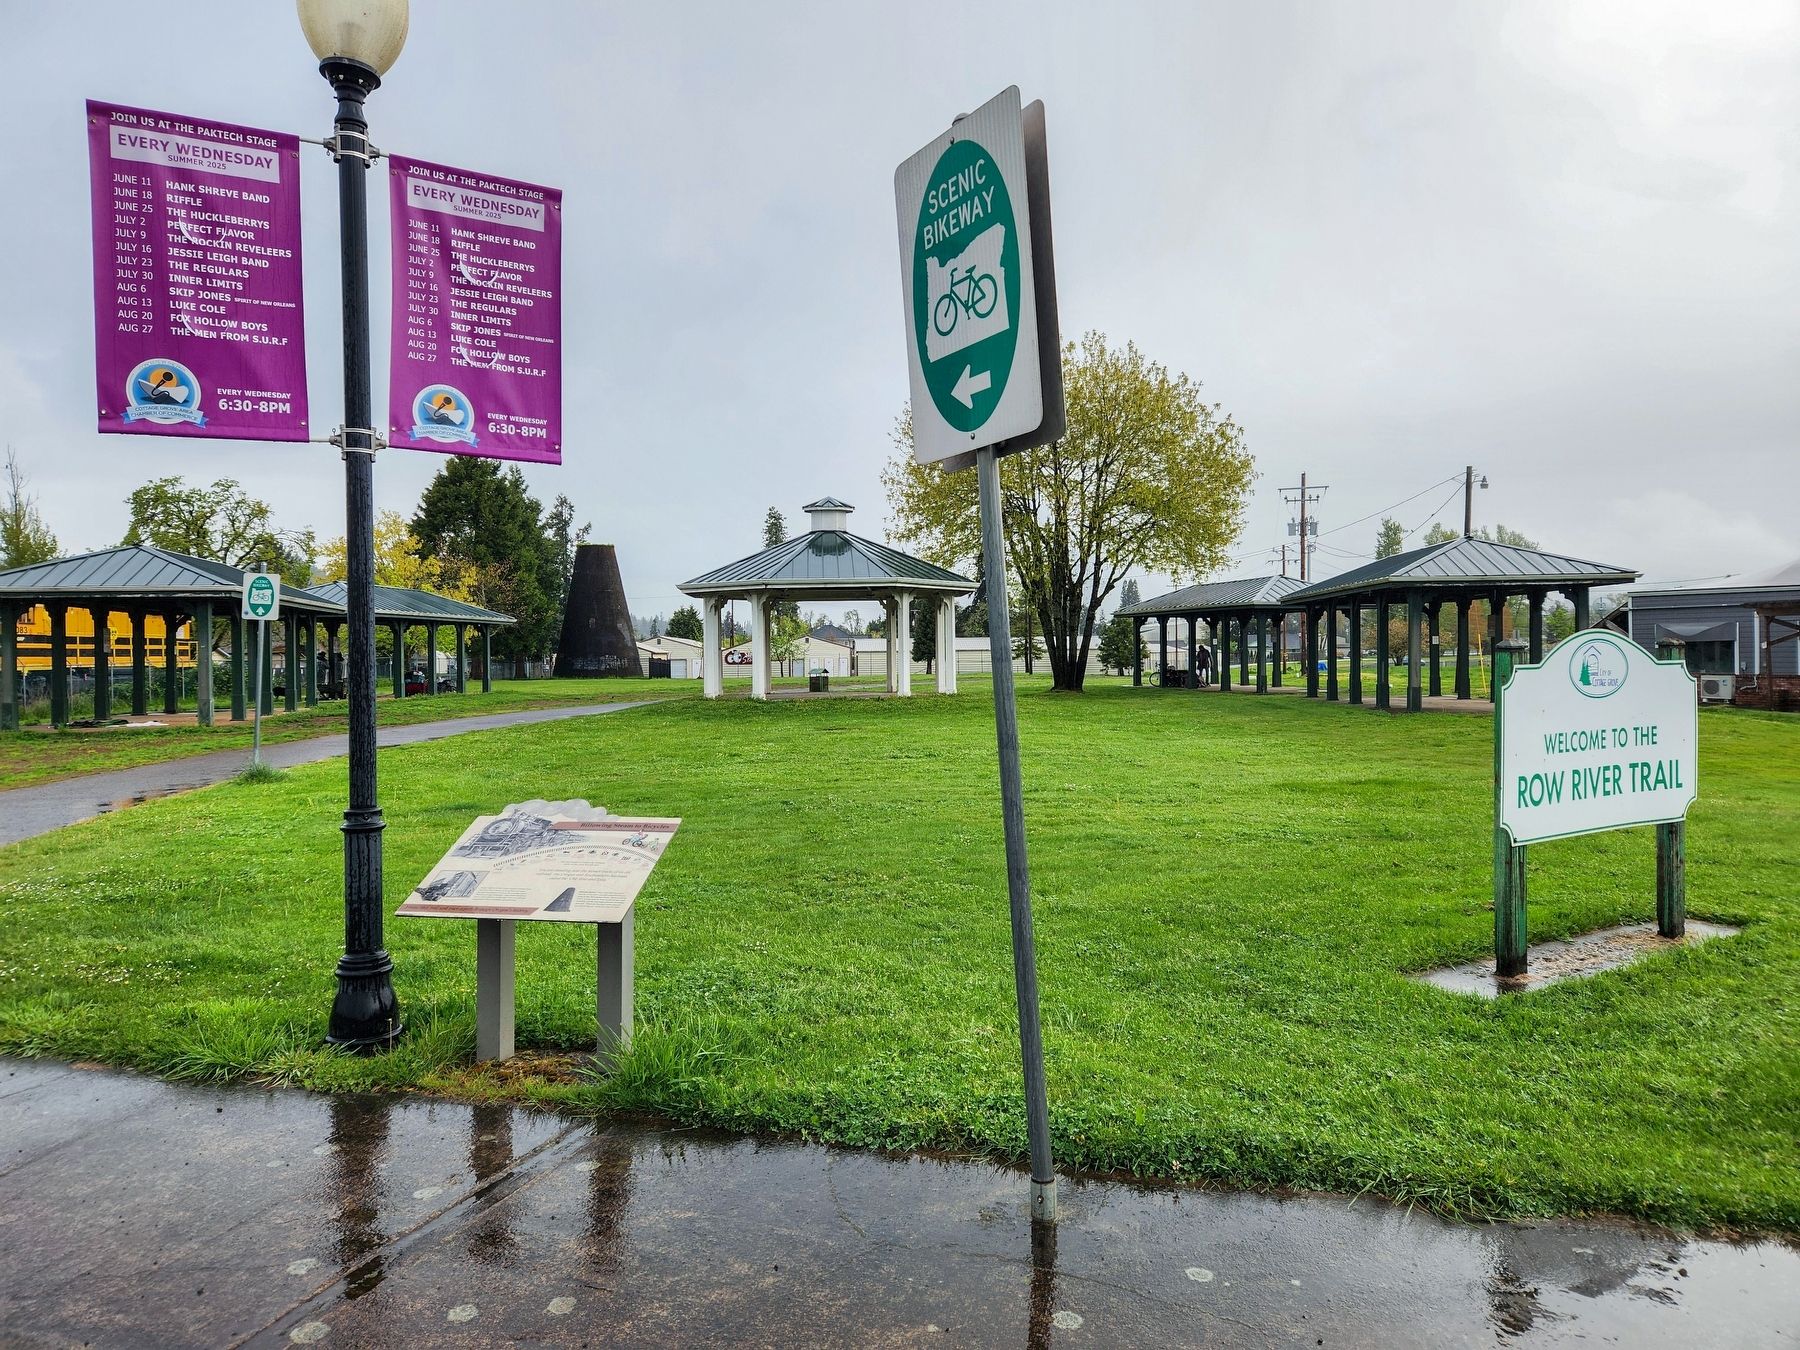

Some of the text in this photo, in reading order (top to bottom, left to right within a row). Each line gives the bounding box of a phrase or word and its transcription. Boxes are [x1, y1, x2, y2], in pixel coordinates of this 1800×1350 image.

[110, 111, 276, 147] JOIN US AT THE PAKTECH STAGE
[117, 133, 272, 169] EVERY WEDNESDAY
[167, 154, 226, 170] SUMMER 2025
[112, 172, 269, 203] JUNE 11 HANK SHREVE BAND
[408, 165, 543, 200] JOIN US AT THE PAKTECH STAGE
[928, 159, 985, 214] SCENIC
[113, 186, 202, 206] JUNE 18 RIFFLE
[413, 184, 539, 219] EVERY WEDNESDAY
[113, 199, 269, 229] JUNE 25 THE HUCKLEBERRYS
[453, 204, 501, 219] SUMMER 2025
[924, 186, 994, 250] BIKEWAY
[114, 213, 136, 224] JULY
[139, 217, 145, 225] 2
[216, 227, 254, 240] FLAVOR
[408, 219, 535, 250] JUNE 11 HANK SHREVE BAND
[114, 227, 291, 257] JULY 9 THE ROCKIN REVELEERS
[408, 231, 480, 252] JUNE 18 RIFFLE
[115, 241, 269, 268] JULY 16 JESSIE LEIGH BAND
[115, 254, 249, 277] JULY 23 THE REGULARS
[408, 243, 535, 273] JUNE 25 THE HUCKLEBERRYS
[408, 255, 426, 265] JULY
[429, 258, 433, 267] 2
[116, 268, 243, 290] JULY 30 INNER LIMITS
[408, 267, 426, 277] JULY
[429, 270, 433, 279] 9
[451, 274, 467, 284] THE
[506, 284, 552, 298] REVELEERS
[116, 282, 137, 292] AUG
[140, 284, 146, 292] 6
[169, 287, 194, 298] SKIP
[197, 290, 231, 301] JONES
[408, 279, 533, 307] JULY 16 JESSIE LEIGH BAND
[408, 291, 516, 316] JULY 23 THE REGULARS
[116, 295, 225, 313] AUG 13 LUKE COLE
[408, 303, 511, 326] JULY 30 INNER LIMITS
[117, 309, 267, 331] AUG 20 FOX HOLLOW BOYS
[117, 322, 138, 332] AUG
[142, 324, 153, 333] 27
[170, 327, 190, 337] THE
[194, 329, 216, 339] MEN
[220, 331, 248, 342] FROM
[408, 315, 500, 336] AUG 6 SKIP JONES
[408, 327, 496, 347] AUG 13 LUKE COLE
[408, 339, 424, 348] AUG
[427, 342, 436, 350] 20
[470, 348, 504, 360] HOLLOW
[508, 354, 529, 364] BOYS
[408, 351, 424, 360] AUG
[427, 354, 436, 362] 27
[450, 357, 466, 366] THE
[491, 362, 514, 373] FROM
[217, 388, 291, 399] EVERY WEDNESDAY
[218, 398, 290, 413] 6:30-8PM
[488, 412, 547, 425] EVERY WEDNESDAY
[488, 421, 546, 438] 6:30-8PM
[1544, 725, 1658, 755] WELCOME TO THE
[1517, 759, 1683, 809] ROW RIVER TRAIL
